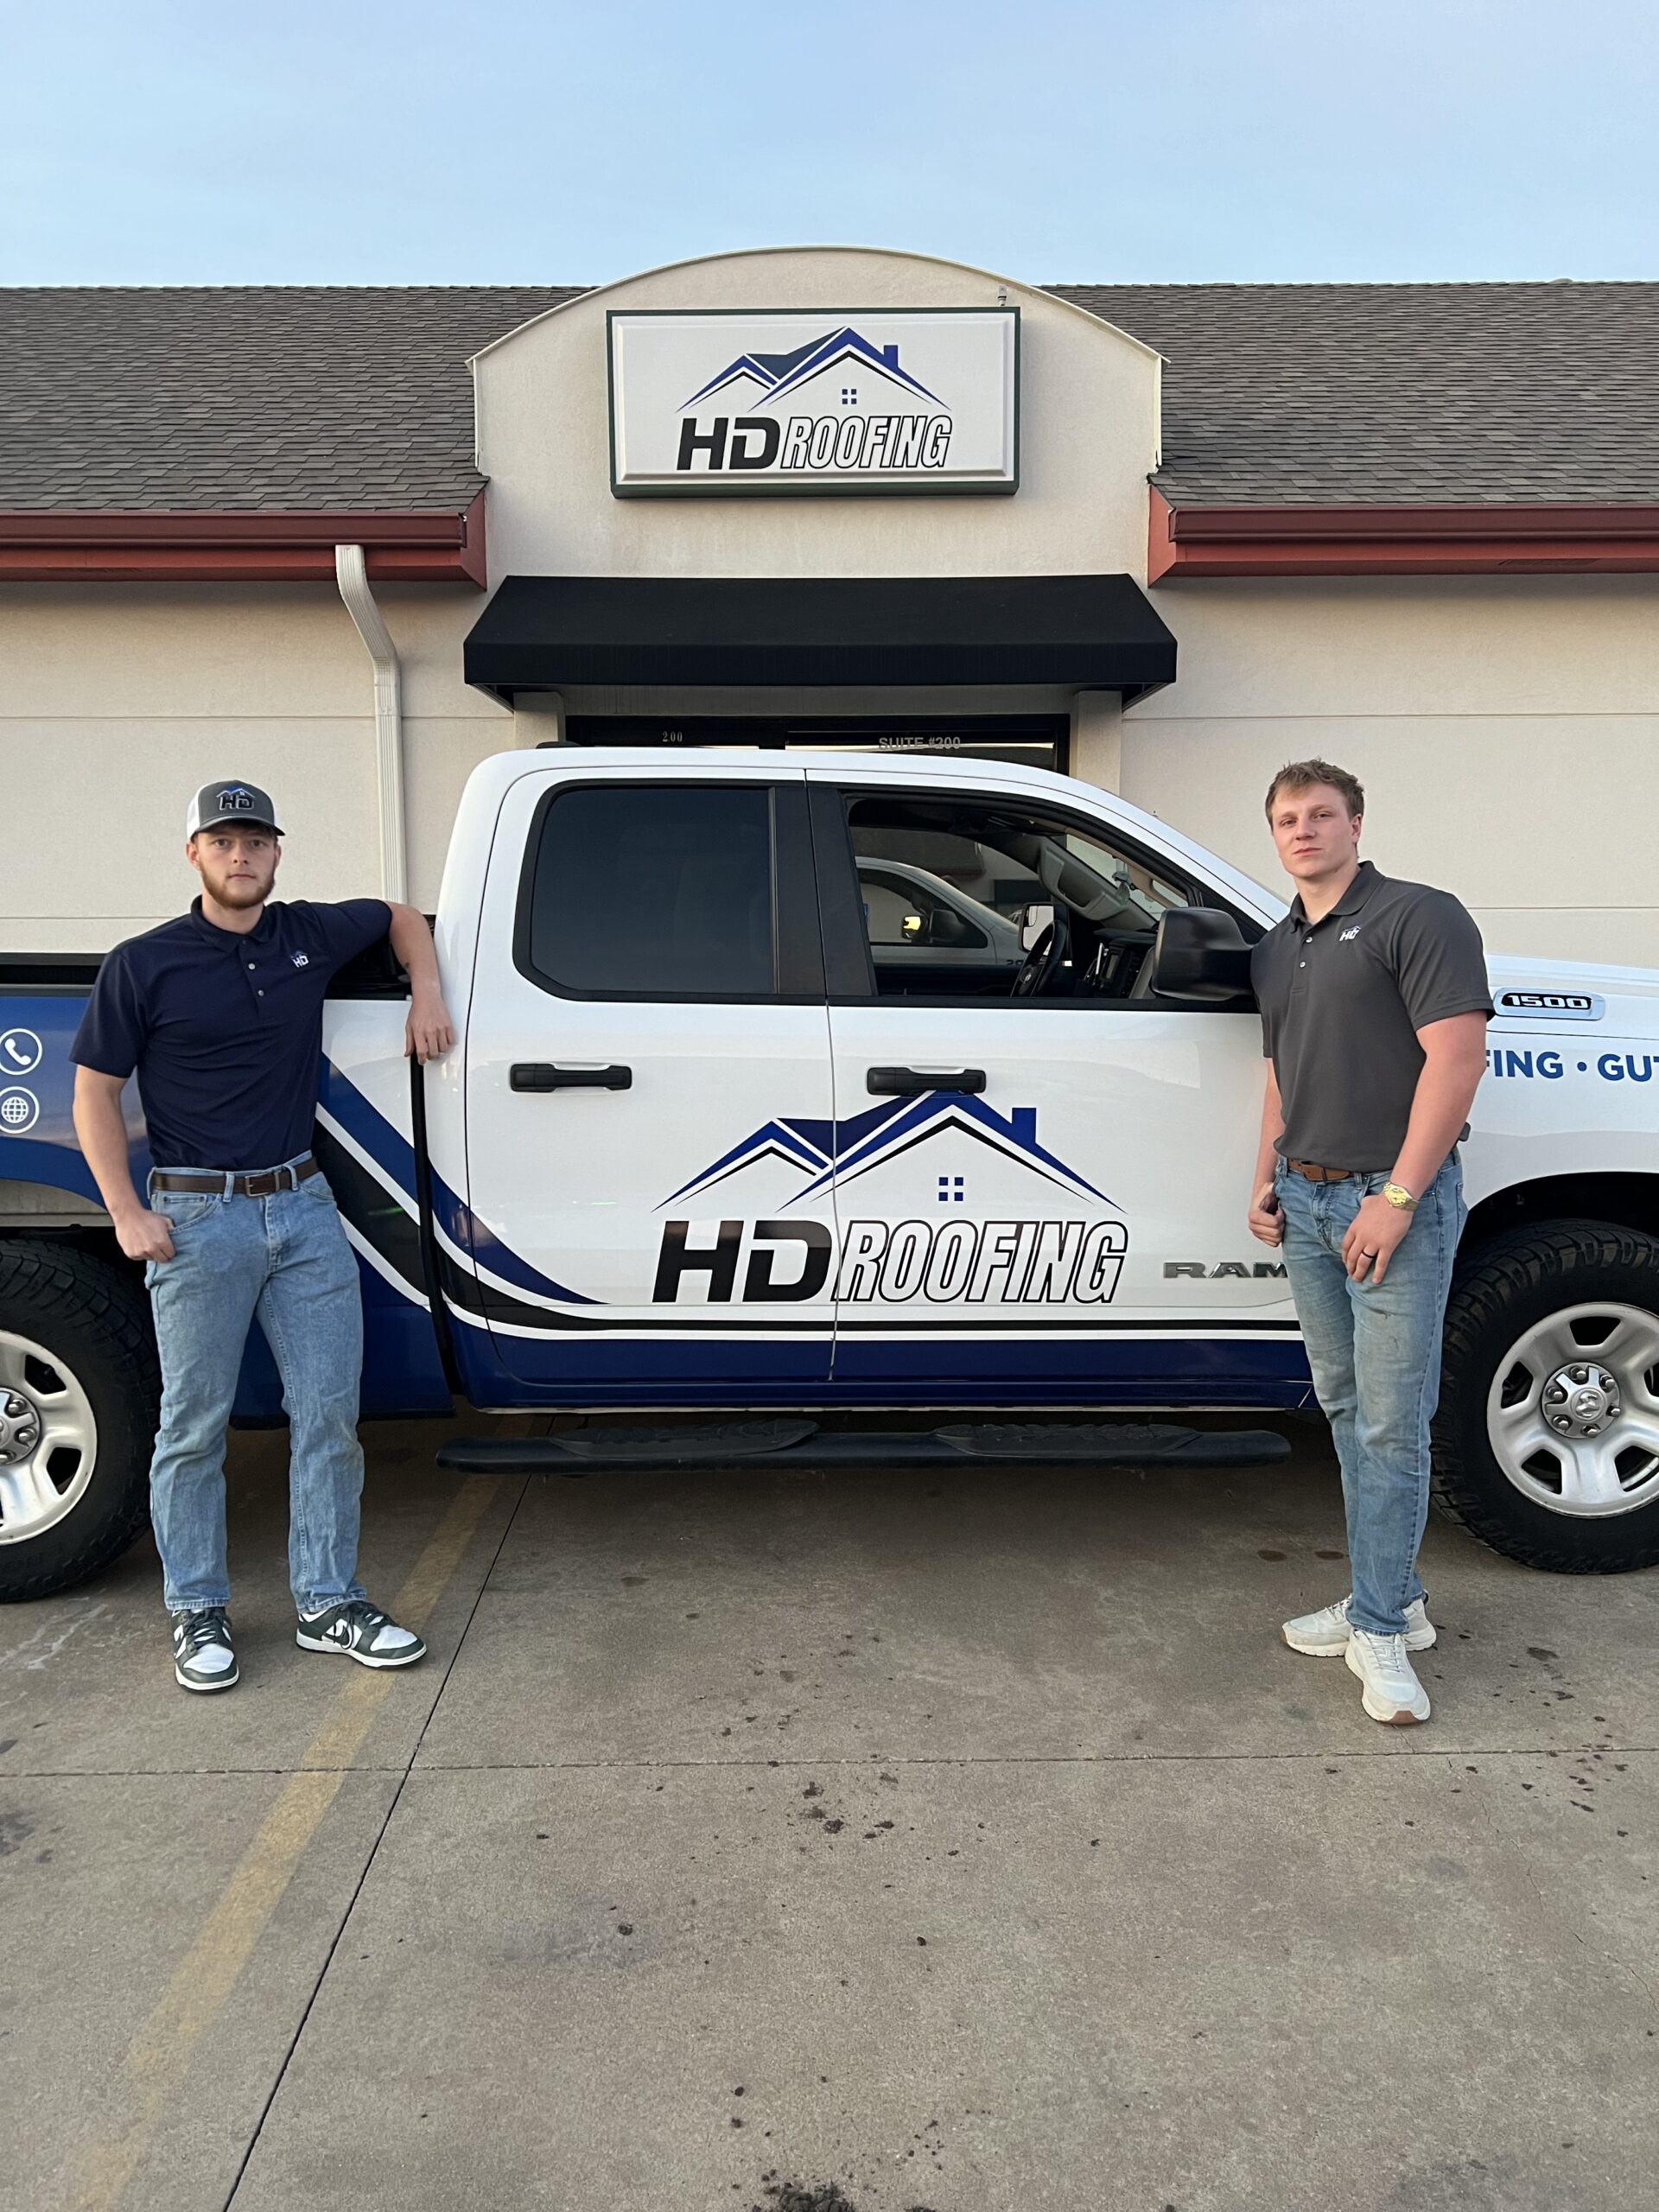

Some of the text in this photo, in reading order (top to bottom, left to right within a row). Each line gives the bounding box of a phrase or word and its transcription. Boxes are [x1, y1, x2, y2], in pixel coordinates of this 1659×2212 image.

[677, 415, 953, 471] HD ROOFING
[662, 730, 683, 742] 200
[879, 736, 962, 750] SUITE #200
[219, 794, 255, 811] HD
[1338, 928, 1361, 942] HD
[291, 955, 309, 968] HD
[1506, 994, 1589, 1009] 1500
[1485, 1049, 1565, 1080] ING
[652, 1219, 1128, 1304] HD ROOFING
[1163, 1262, 1288, 1279] RAM
